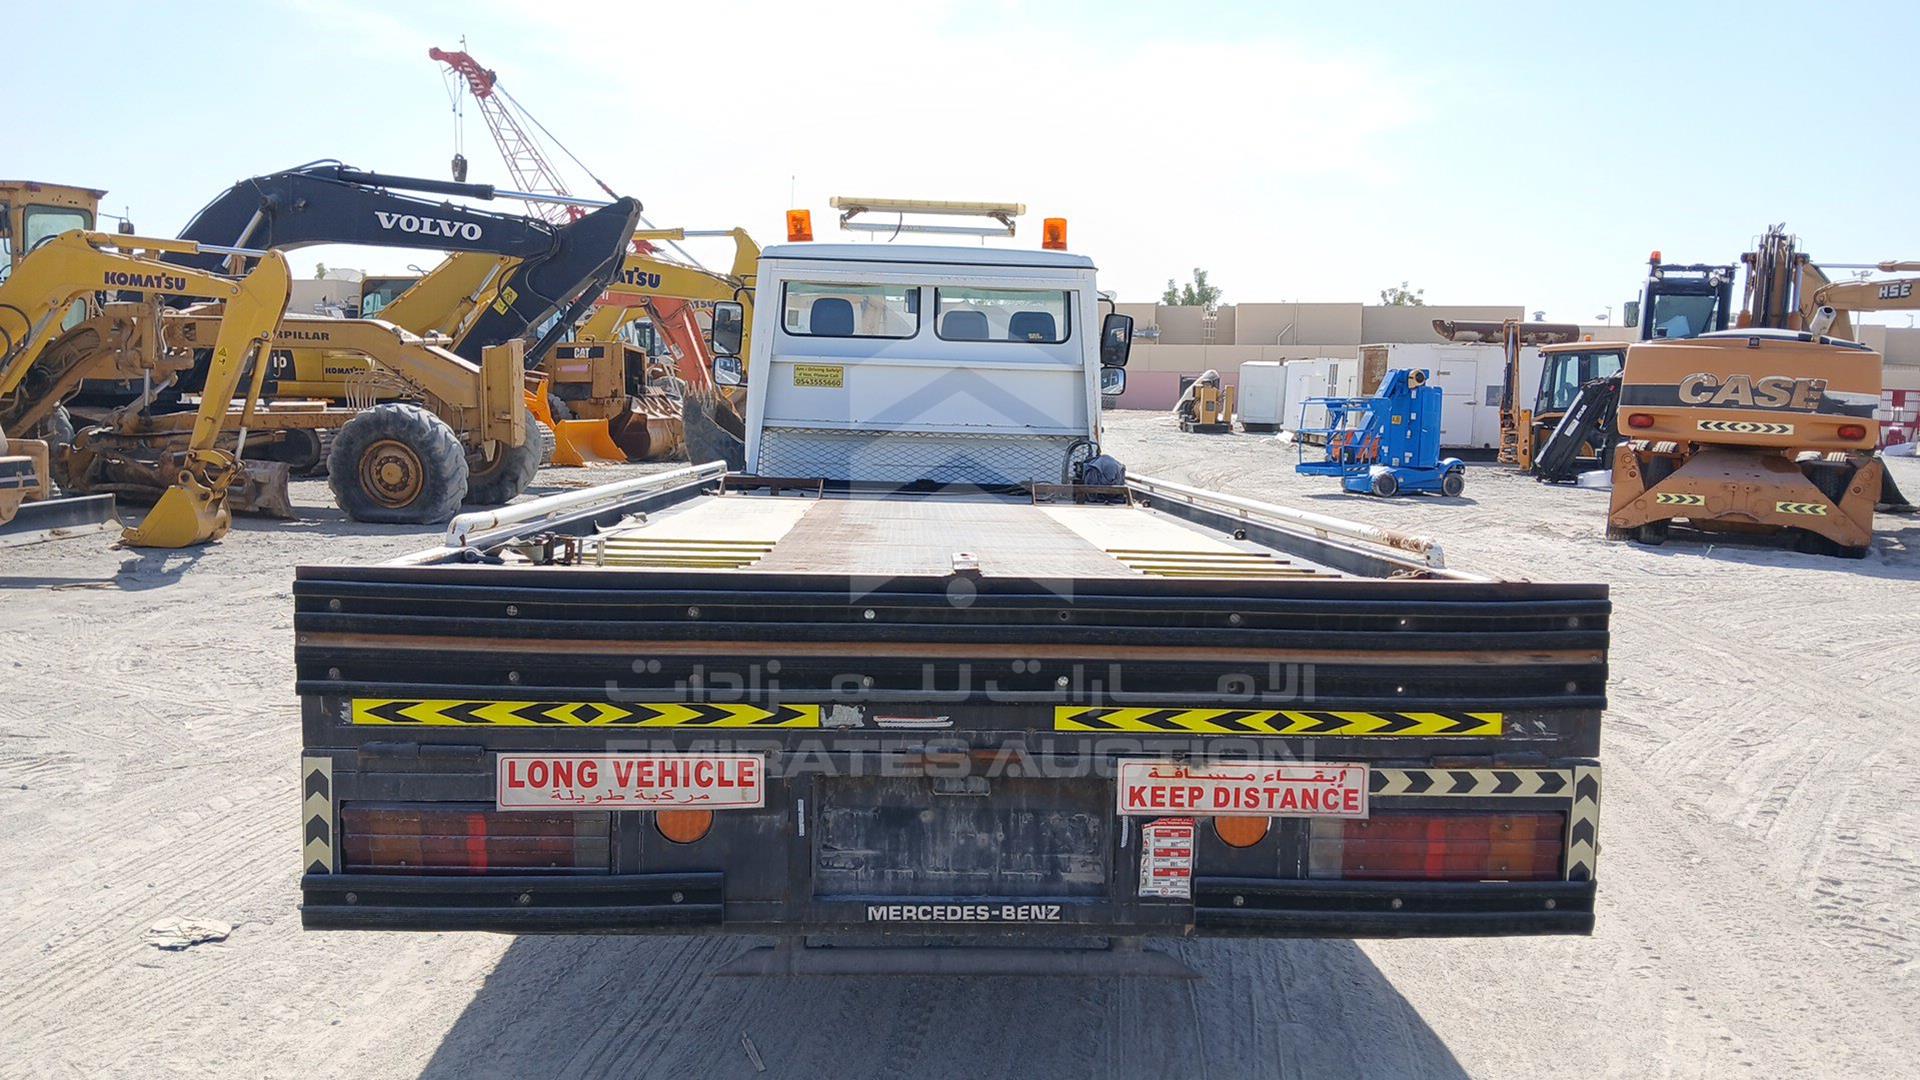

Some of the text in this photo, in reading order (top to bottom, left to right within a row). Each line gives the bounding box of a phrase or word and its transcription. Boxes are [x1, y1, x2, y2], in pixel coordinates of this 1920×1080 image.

[374, 211, 483, 241] VOLVO
[104, 271, 186, 291] KOMATSU
[1879, 284, 1912, 299] HSE
[574, 347, 590, 359] CAT
[1678, 372, 1829, 409] CASE
[507, 760, 755, 788] LONG VEHICLE
[1148, 767, 1256, 783] مسافة
[551, 789, 710, 804] مركبة طويلة
[1128, 785, 1360, 811] KEEP DISTANCE
[867, 905, 1061, 921] MERCEDES-BENZ
